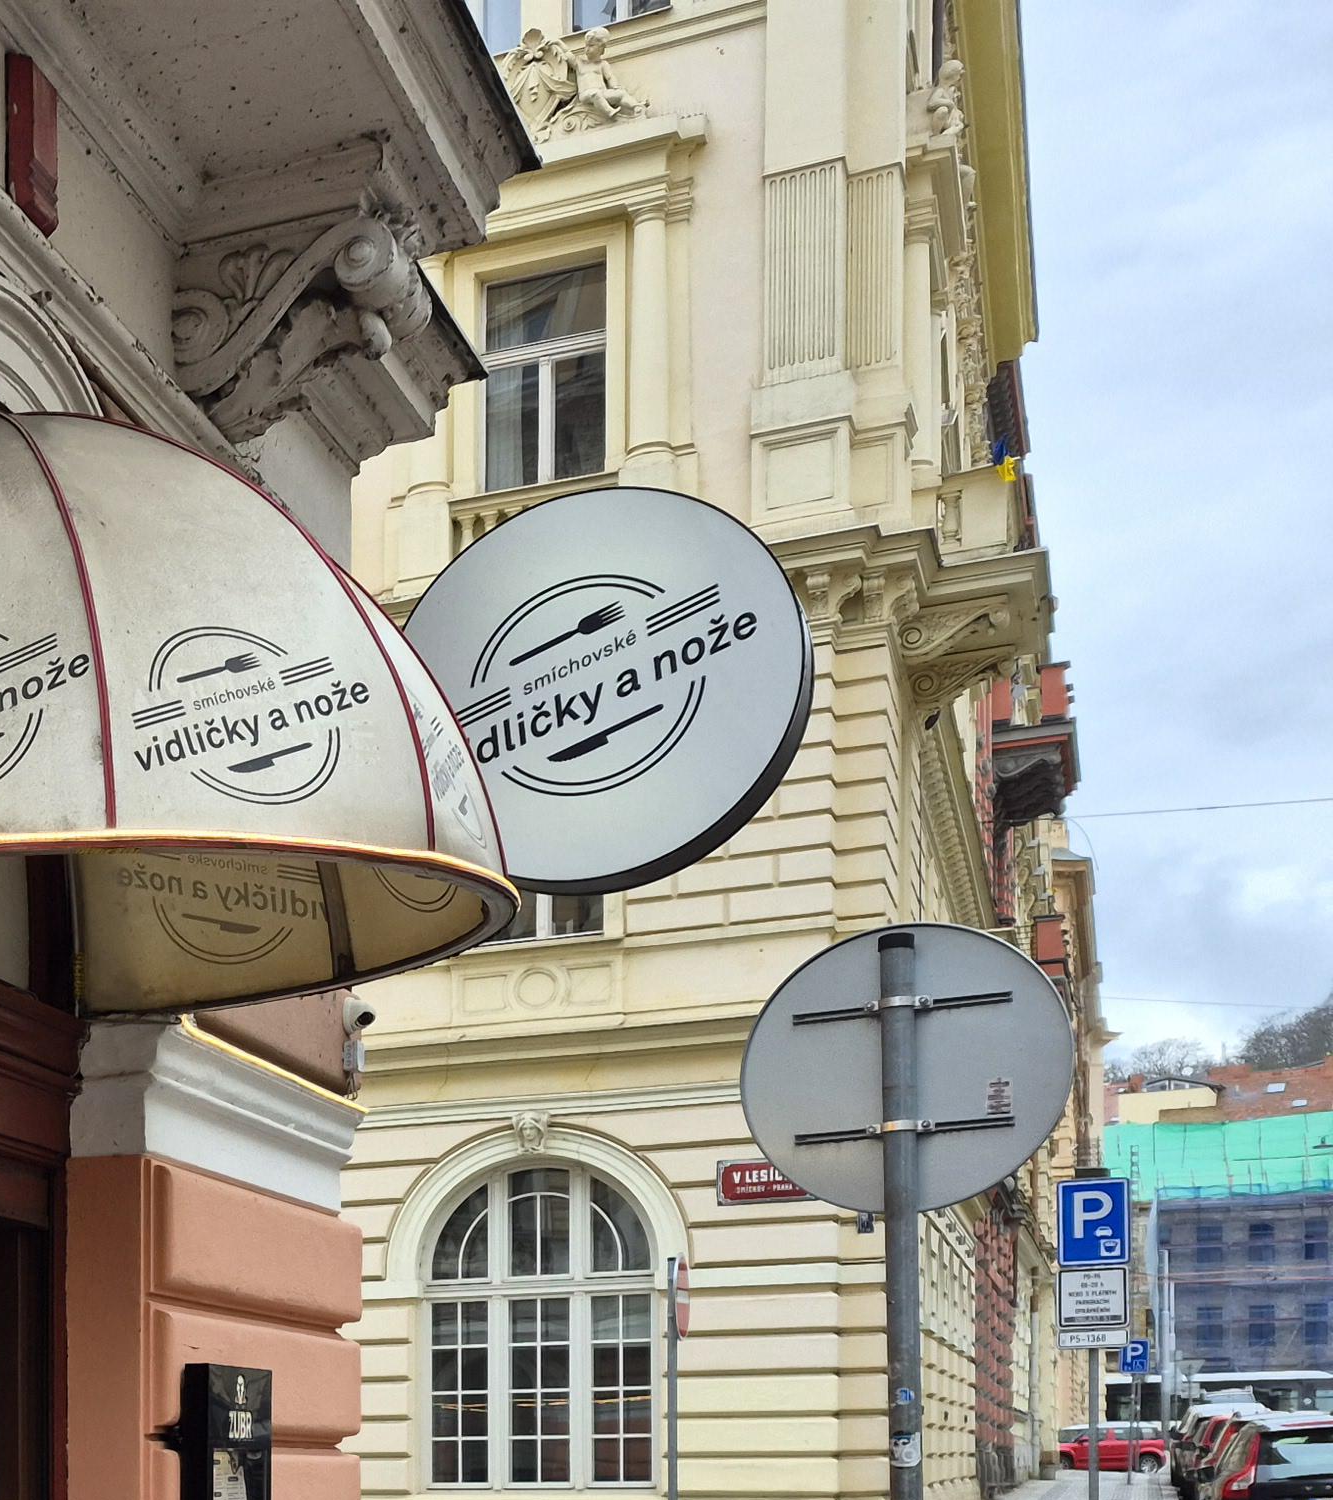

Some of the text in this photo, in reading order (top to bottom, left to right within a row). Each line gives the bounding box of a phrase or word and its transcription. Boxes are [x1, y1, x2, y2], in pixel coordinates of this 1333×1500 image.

[523, 629, 637, 695] smíchovské
[193, 677, 276, 710] smíchovské
[477, 611, 757, 763] dličky a nože
[134, 680, 370, 771] vidličky a nože
[733, 1166, 787, 1184] V LESÍ
[1073, 1191, 1113, 1239] P
[1126, 1343, 1143, 1363] P
[228, 1410, 253, 1439] ZUBR
